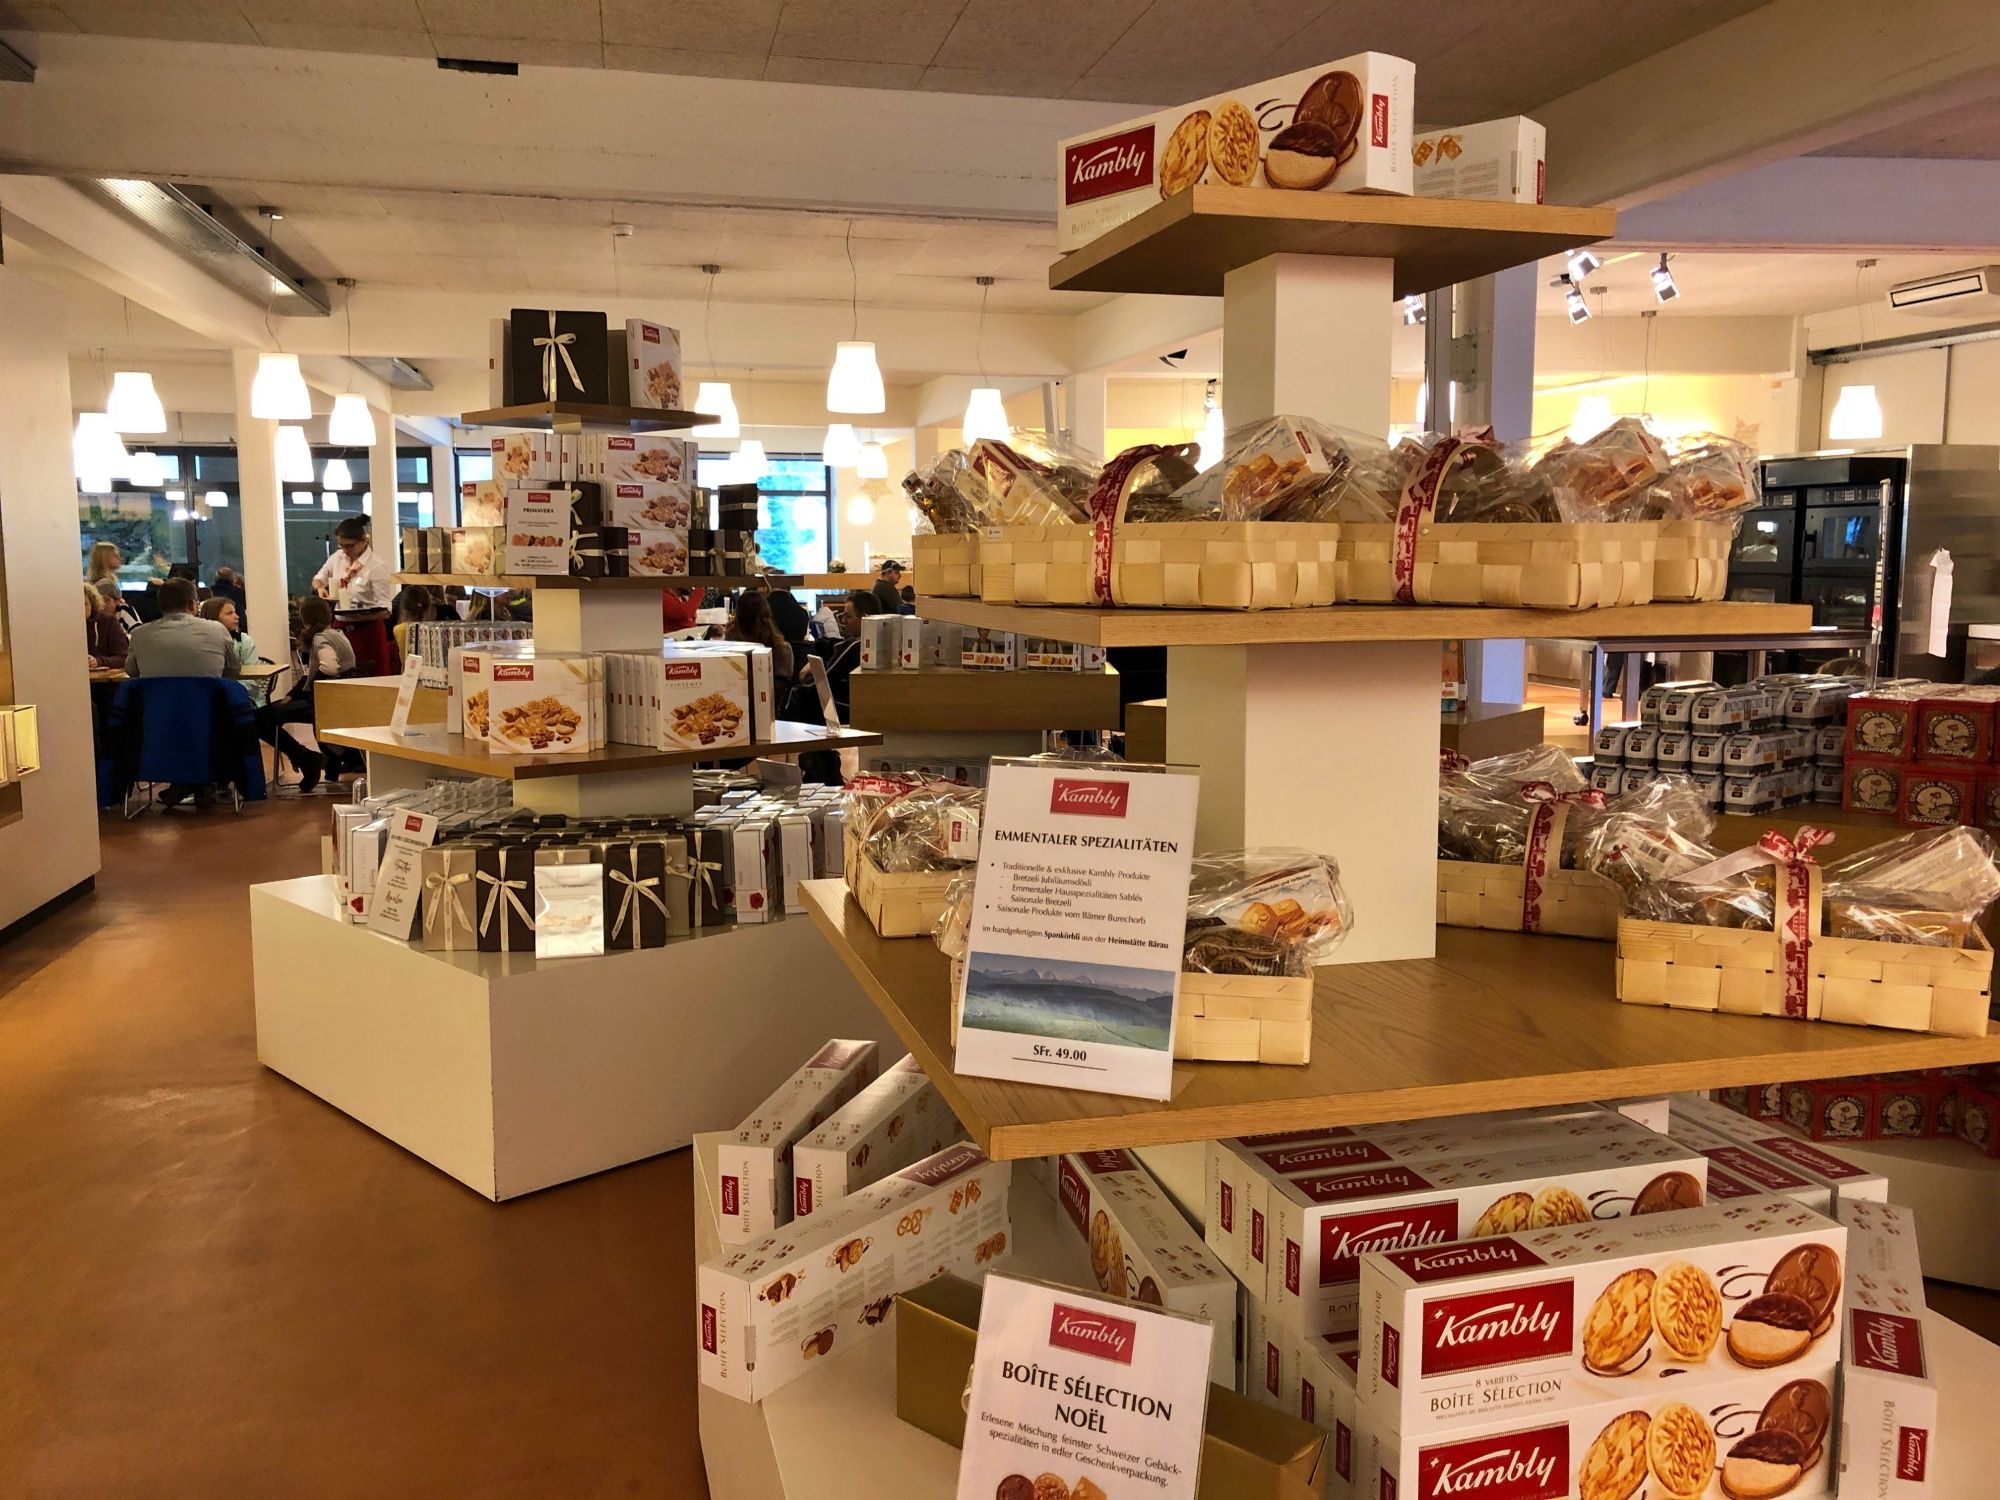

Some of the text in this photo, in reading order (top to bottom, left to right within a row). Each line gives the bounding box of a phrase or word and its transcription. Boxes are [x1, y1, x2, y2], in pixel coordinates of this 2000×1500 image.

[1375, 99, 1386, 144] Kambly
[1072, 143, 1146, 185] Kambly
[497, 667, 531, 678] Kambly
[668, 665, 698, 676] Kambly
[1058, 786, 1121, 810] Kambly
[994, 830, 1179, 854] EMMENTALER SPEZIALITÄTEN
[1003, 862, 1151, 881] Traditionelle & exklusive Kambly Produkte
[1013, 873, 1040, 883] Bretzeli
[1010, 894, 1072, 907] Saisonale Bretzeli
[1012, 884, 1143, 902] Emmentaler Hausspezialitäten Sablés
[997, 903, 1030, 914] Saisonale
[1031, 906, 1063, 917] Produkte
[1064, 911, 1081, 919] vom
[992, 925, 1043, 938] handgefertigten
[1044, 929, 1081, 940] Spankörbli
[1081, 934, 1094, 942] aus
[1094, 934, 1106, 943] der
[1107, 936, 1147, 947] Heimstätte
[1147, 940, 1169, 949] Bärau
[1033, 1044, 1087, 1061] SFr. 49.00
[915, 1150, 977, 1180] Kambly
[1279, 1144, 1369, 1165] Kambly
[723, 1177, 734, 1212] Kambly
[799, 1179, 810, 1215] Kambly
[1061, 1169, 1088, 1224] Kambly
[1315, 1173, 1409, 1193] Kambly
[1222, 1188, 1231, 1227] Kambly
[1253, 1214, 1264, 1256] Kambly
[1332, 1220, 1446, 1261] Kambly
[1287, 1245, 1299, 1290] Kambly
[1413, 1246, 1518, 1272] Kambly
[704, 1308, 713, 1349] Kambly
[1058, 1317, 1127, 1353] Kambly
[1435, 1301, 1561, 1348] Kambly
[1386, 1330, 1399, 1379] Kambly
[1866, 1317, 1905, 1369] Kambly
[1002, 1361, 1173, 1421] BOÎTE SÉLECTION
[1430, 1380, 1562, 1412] BOÎTE SÉLECTION
[1475, 1379, 1482, 1388] 8
[1054, 1403, 1108, 1434] NOËL
[980, 1411, 1182, 1475] Erlesene Mischung feinster Schweizer Gebäck-
[989, 1427, 1039, 1450] spezialitäten
[1041, 1442, 1050, 1453] in
[1051, 1446, 1073, 1459] edler
[1903, 1431, 1921, 1477] Kambly
[1432, 1446, 1557, 1497] Kambly
